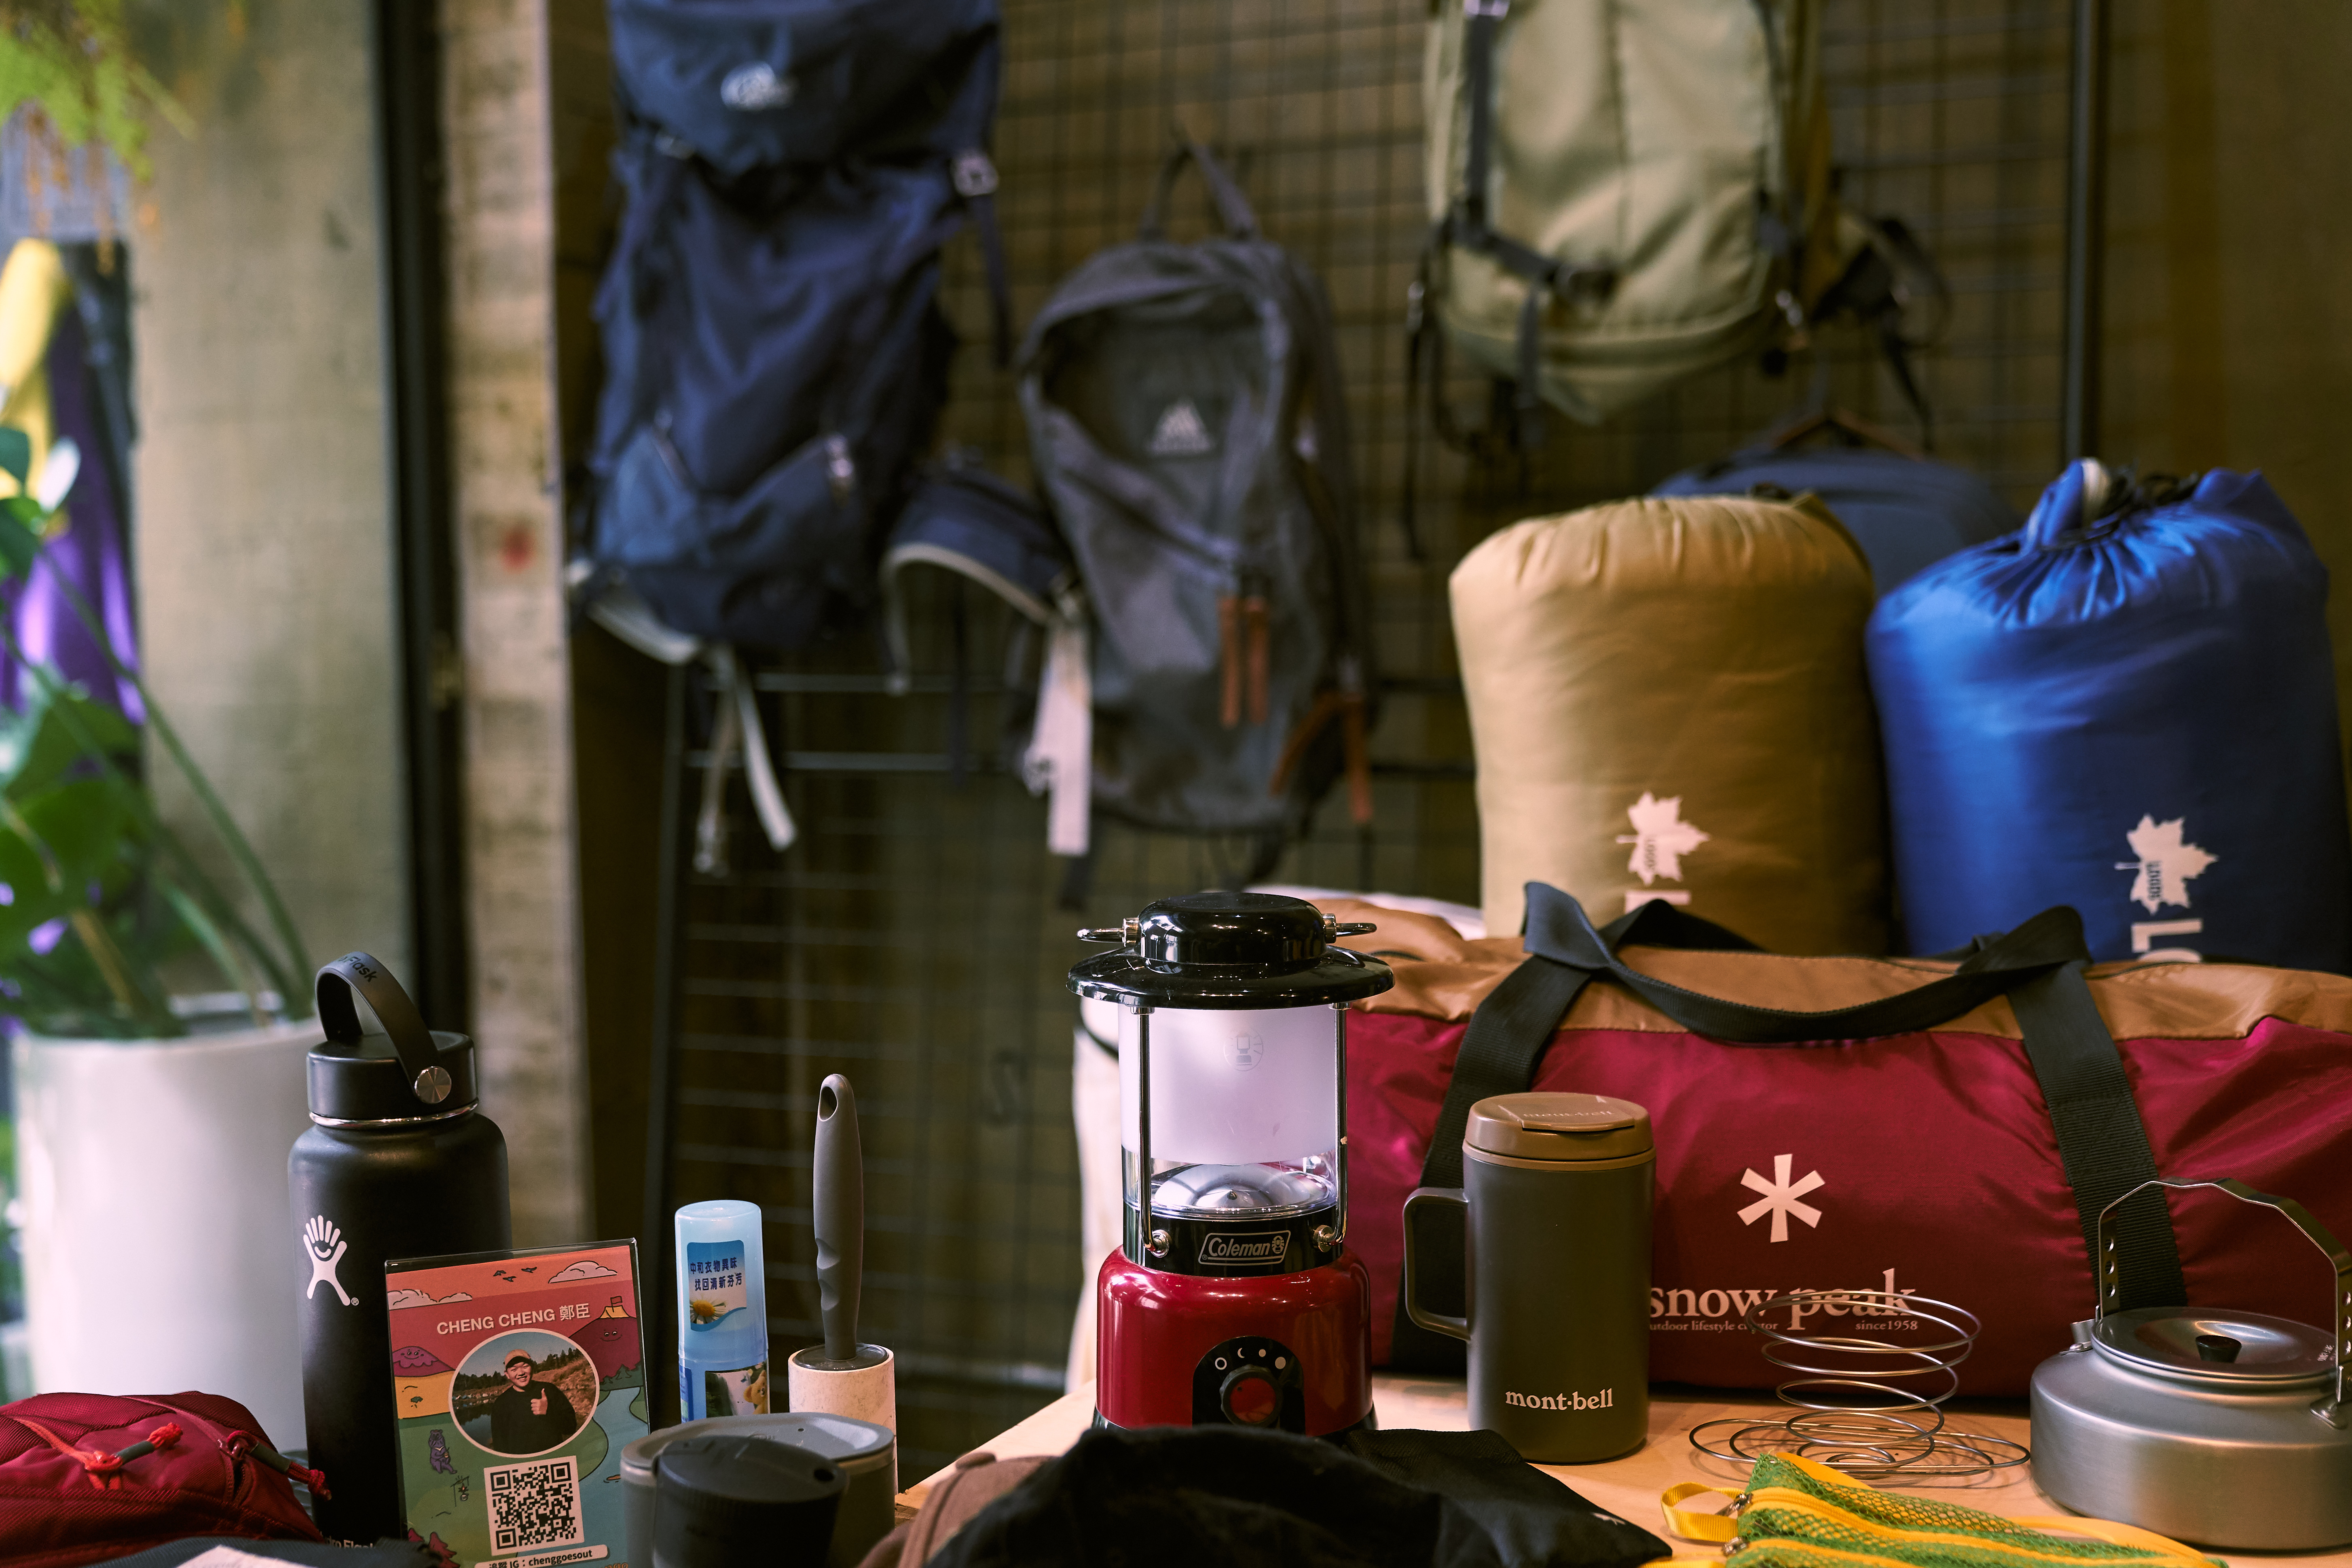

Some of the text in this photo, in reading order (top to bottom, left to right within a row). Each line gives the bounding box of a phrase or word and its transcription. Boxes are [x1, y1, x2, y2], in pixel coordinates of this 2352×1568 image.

[1208, 1237, 1271, 1257] Coleman
[690, 1257, 737, 1274] 中和衣物異味
[695, 1272, 742, 1291] 找回清新芬芳
[1650, 1268, 1916, 1331] snow peak
[437, 1302, 590, 1335] CHENG CHENG 鄭臣
[1650, 1320, 1689, 1331] utdoor
[1692, 1320, 1735, 1333] lifestyle
[529, 1549, 593, 1565] chenggoesout
